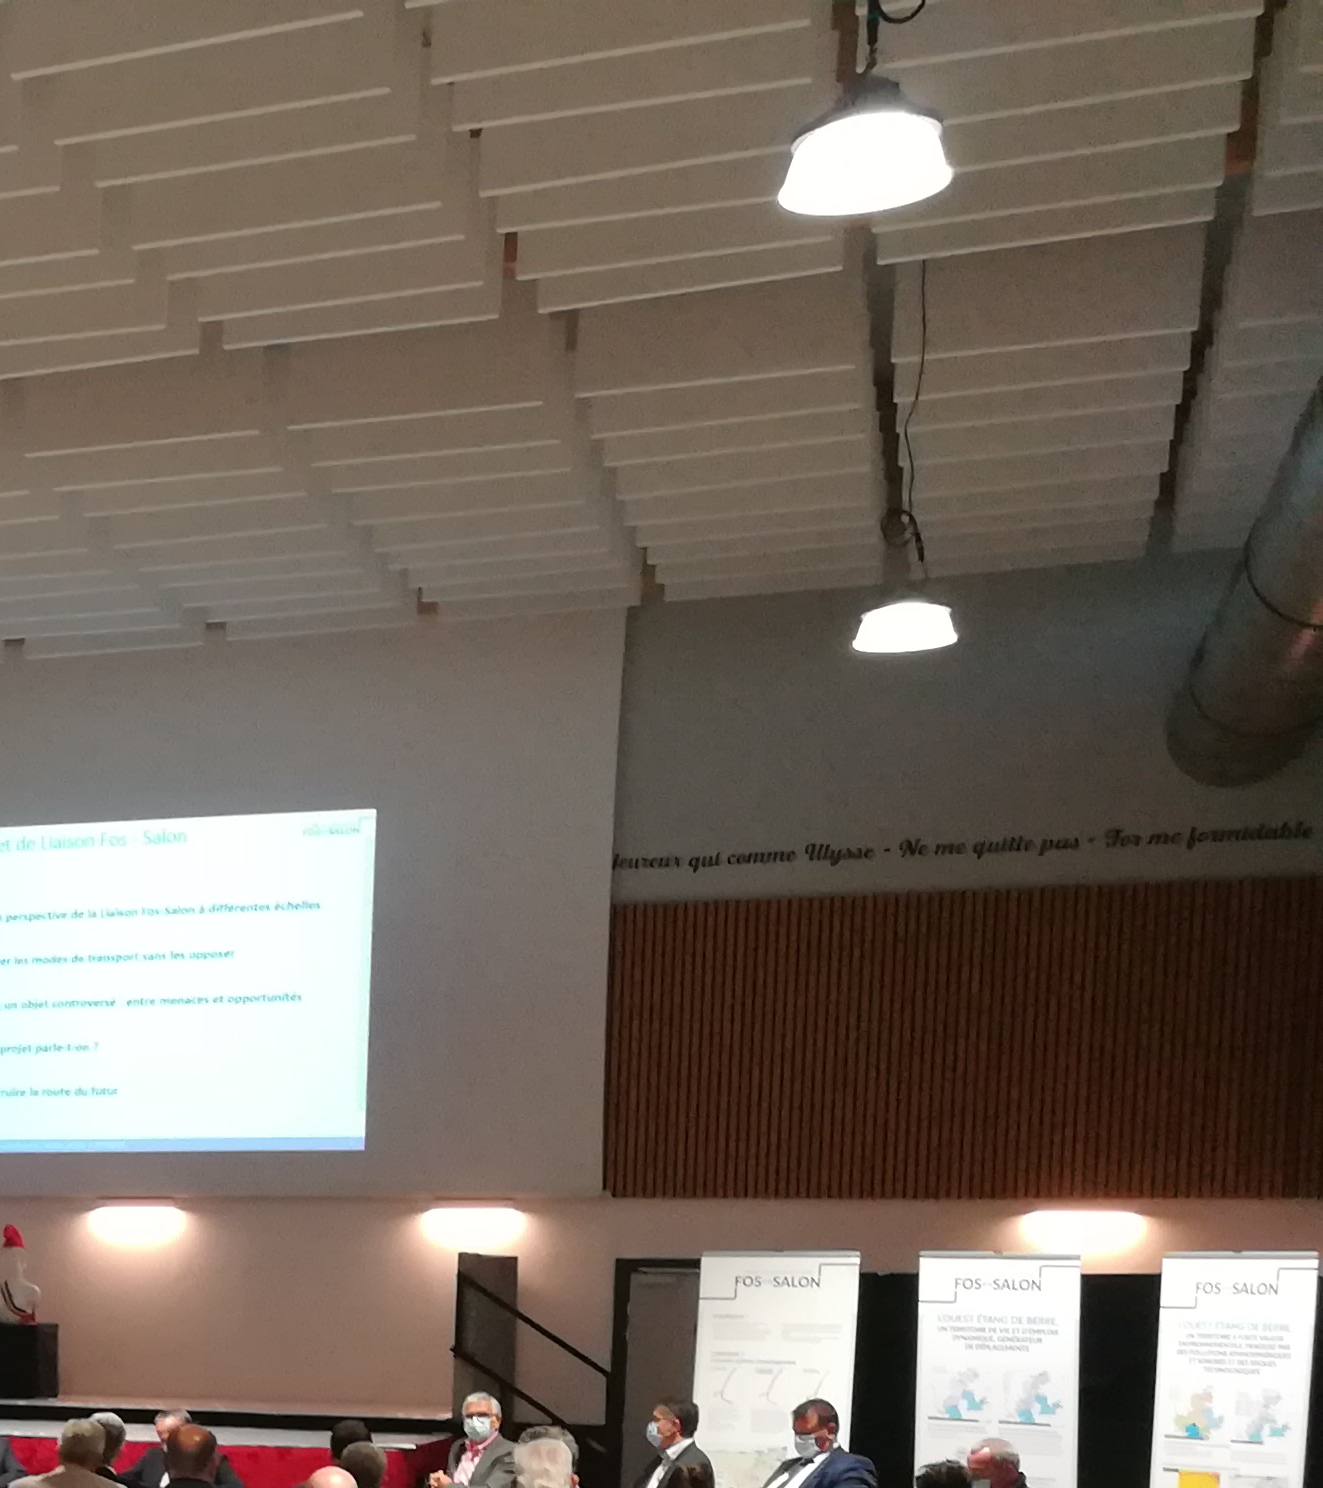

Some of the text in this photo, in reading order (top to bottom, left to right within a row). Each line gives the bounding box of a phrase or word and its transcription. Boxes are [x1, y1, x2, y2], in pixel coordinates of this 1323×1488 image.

[16, 836, 36, 851] de
[41, 834, 96, 850] Liaison
[100, 831, 128, 847] Fos
[144, 829, 188, 846] Salon
[688, 852, 721, 874] qui
[727, 849, 797, 867] comme
[805, 843, 876, 867] Ulysse
[899, 839, 928, 859] Ne
[934, 841, 966, 857] me
[972, 836, 1031, 860] quitte
[1038, 837, 1081, 857] pas
[1146, 831, 1182, 846] me
[1186, 822, 1315, 850] formidable
[6, 911, 68, 924] perspective
[71, 908, 84, 919] de
[88, 909, 97, 919] la
[101, 907, 138, 918] Liaison
[209, 903, 270, 914] différentes
[274, 900, 321, 911] échelles
[14, 956, 28, 966] les
[31, 955, 68, 965] modes
[71, 954, 84, 964] de
[87, 952, 140, 965] transport
[142, 952, 166, 961] sans
[170, 950, 186, 960] les
[188, 950, 235, 962] opposer
[4, 1002, 18, 1011] un
[21, 999, 49, 1011] objet
[126, 997, 156, 1008] entre
[159, 995, 209, 1006] menaces
[212, 995, 224, 1005] et
[227, 992, 303, 1005] opportunités
[0, 1043, 32, 1056] projet
[29, 1087, 39, 1097] la
[42, 1088, 71, 1097] route
[74, 1086, 88, 1097] du
[91, 1086, 119, 1096] futur
[735, 1275, 821, 1289] FOS SALON
[955, 1277, 1042, 1292] FOS SALON
[1196, 1282, 1279, 1295] FOS SALON
[1011, 1316, 1023, 1324] DE
